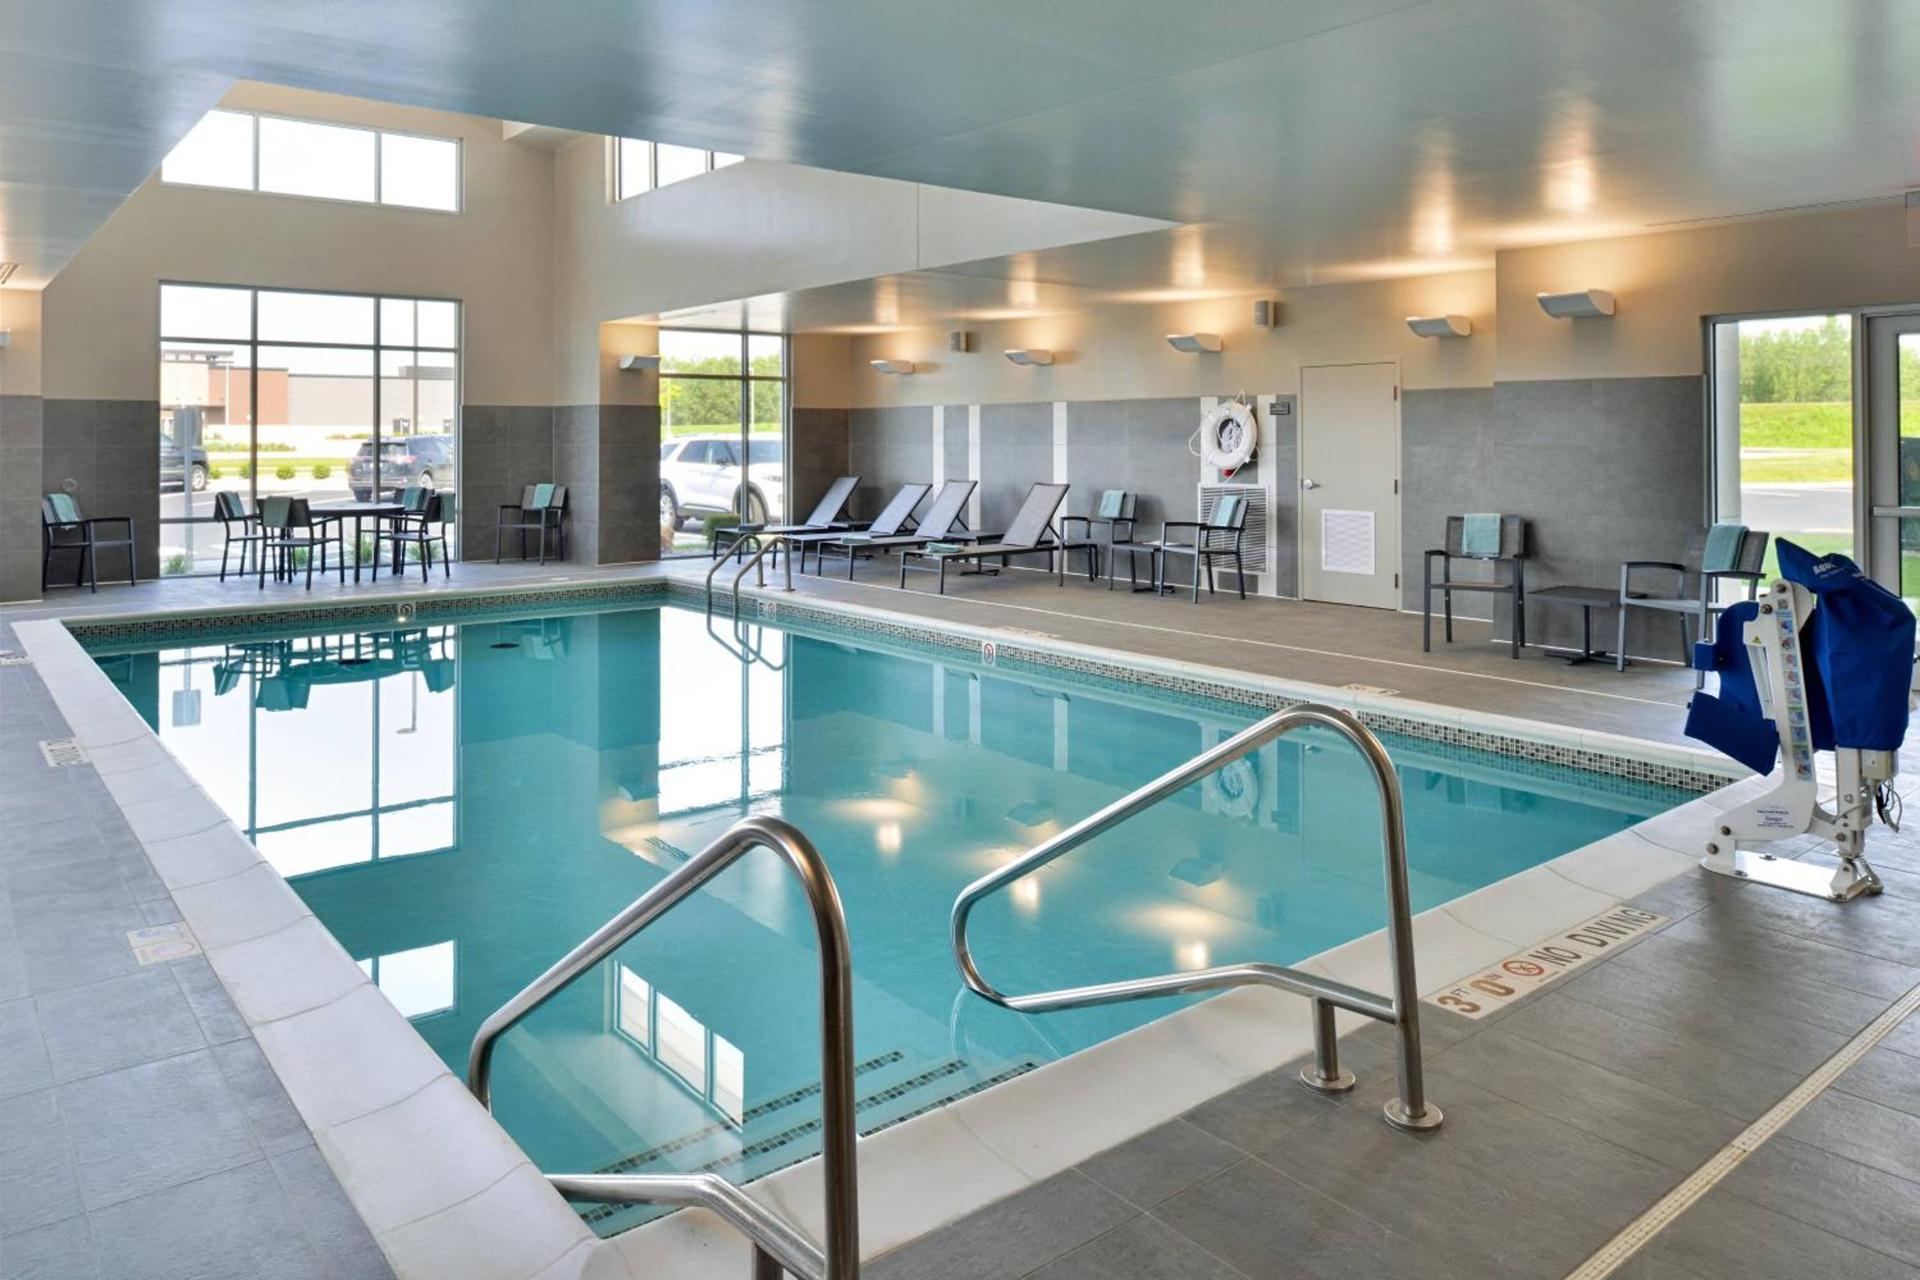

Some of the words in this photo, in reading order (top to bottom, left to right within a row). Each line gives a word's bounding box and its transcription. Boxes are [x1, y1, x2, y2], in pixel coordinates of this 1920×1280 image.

[1438, 995, 1481, 1013] 3
[1469, 979, 1515, 997] 0
[1528, 946, 1582, 967] NO
[1565, 909, 1657, 948] DIVING
